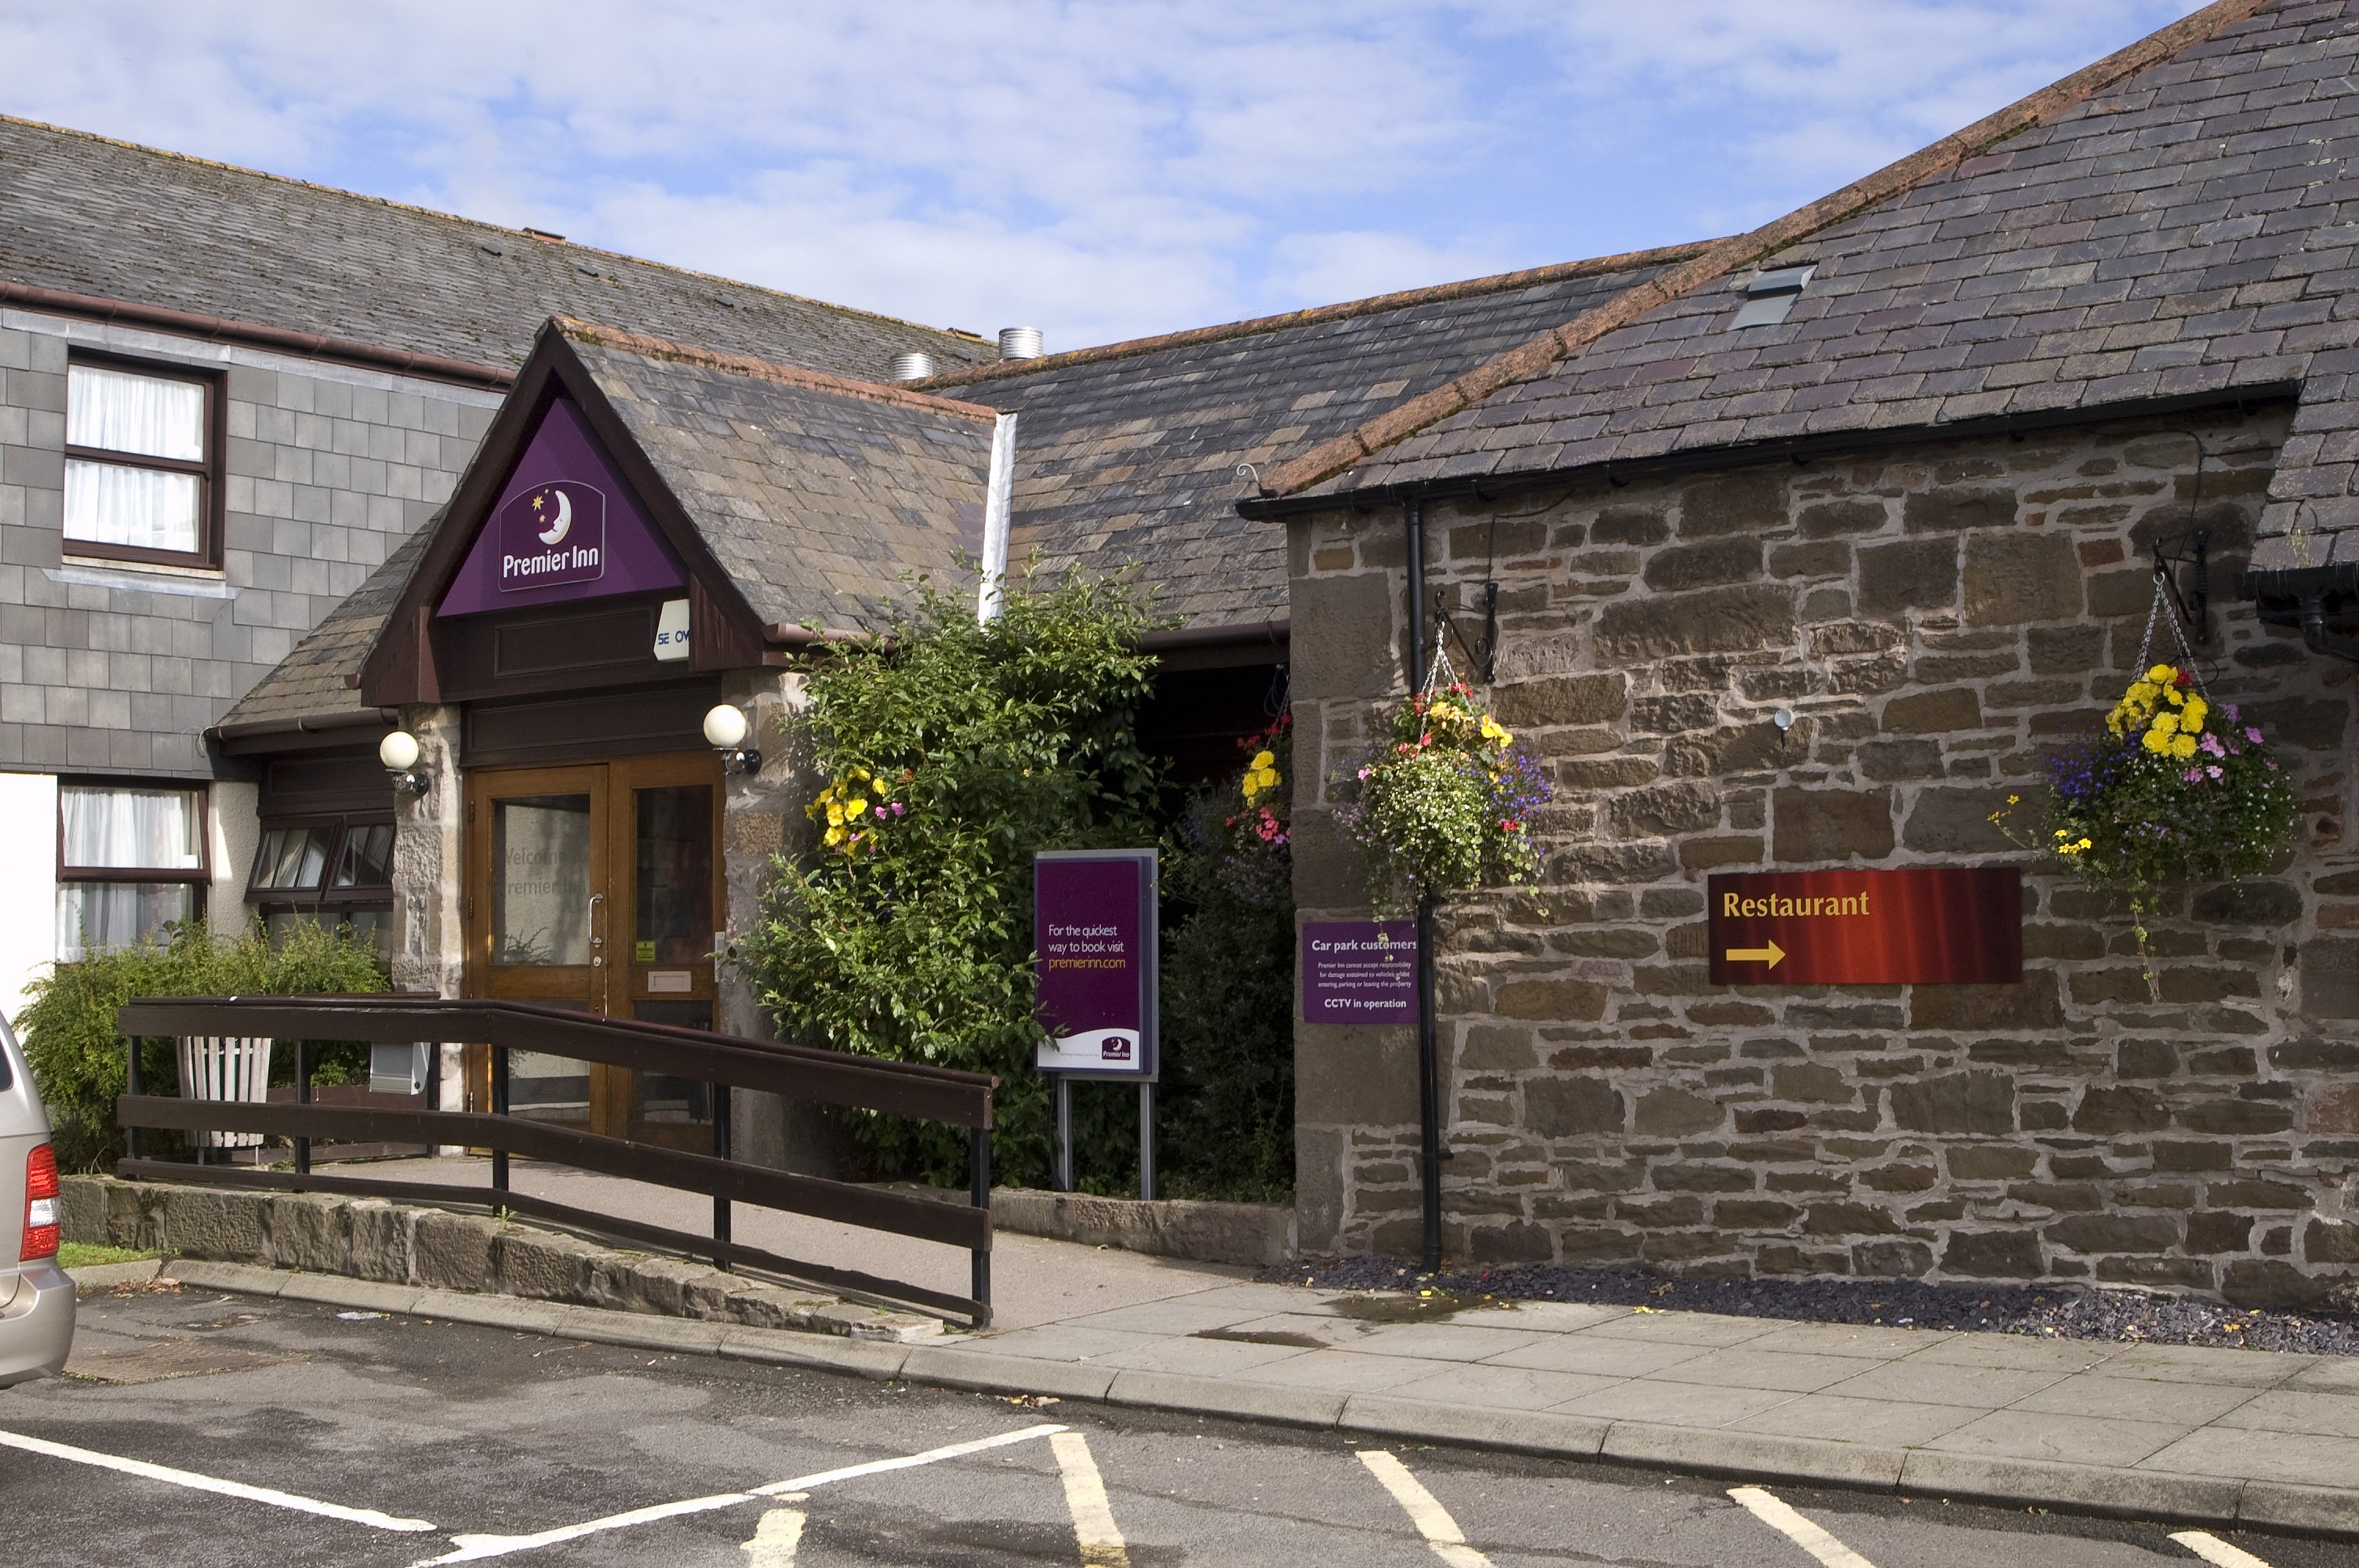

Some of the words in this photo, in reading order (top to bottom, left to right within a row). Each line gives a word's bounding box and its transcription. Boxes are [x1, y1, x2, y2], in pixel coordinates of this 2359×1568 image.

[503, 549, 570, 579] Premier
[572, 545, 598, 568] Inn
[507, 877, 559, 895] remier
[1724, 891, 1870, 917] Restaurant
[1049, 924, 1064, 936] For
[1066, 924, 1081, 936] the
[1082, 924, 1118, 939] quickest
[1049, 943, 1067, 956] way
[1070, 942, 1080, 953] to
[1081, 941, 1106, 953] book
[1107, 940, 1124, 953] visit
[1311, 940, 1332, 951] Car
[1334, 939, 1358, 953] park
[1360, 940, 1417, 951] customers
[1049, 956, 1126, 972] premierinn.com
[1324, 999, 1351, 1008] CCTV
[1353, 999, 1361, 1008] in
[1363, 999, 1407, 1010] operation
